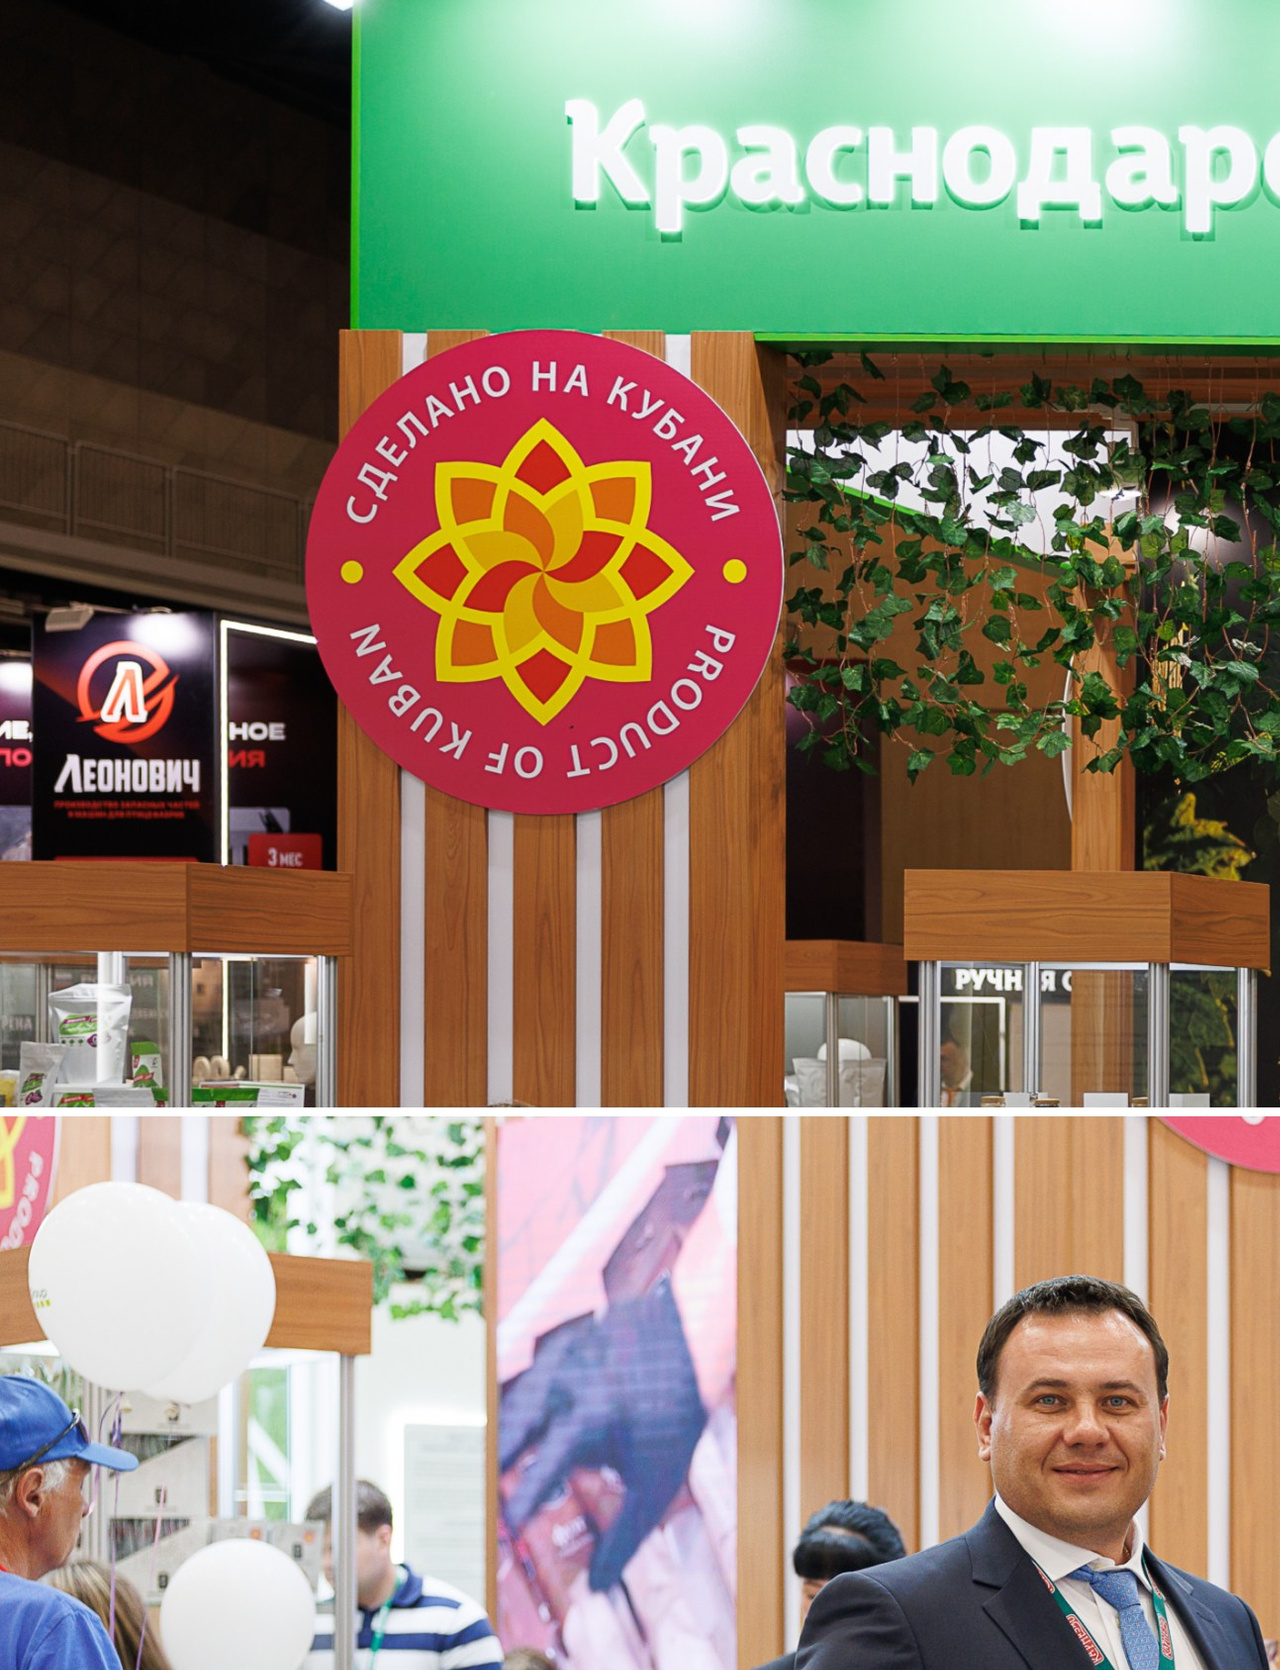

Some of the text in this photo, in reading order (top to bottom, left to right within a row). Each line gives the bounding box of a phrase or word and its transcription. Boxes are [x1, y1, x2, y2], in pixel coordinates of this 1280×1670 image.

[346, 361, 740, 524] СДЕЛАНО НА КУБАНИ
[350, 624, 736, 779] PRODUCT OF KUBAN
[268, 848, 278, 867] 3
[955, 968, 1057, 992] РУЧНЯ
